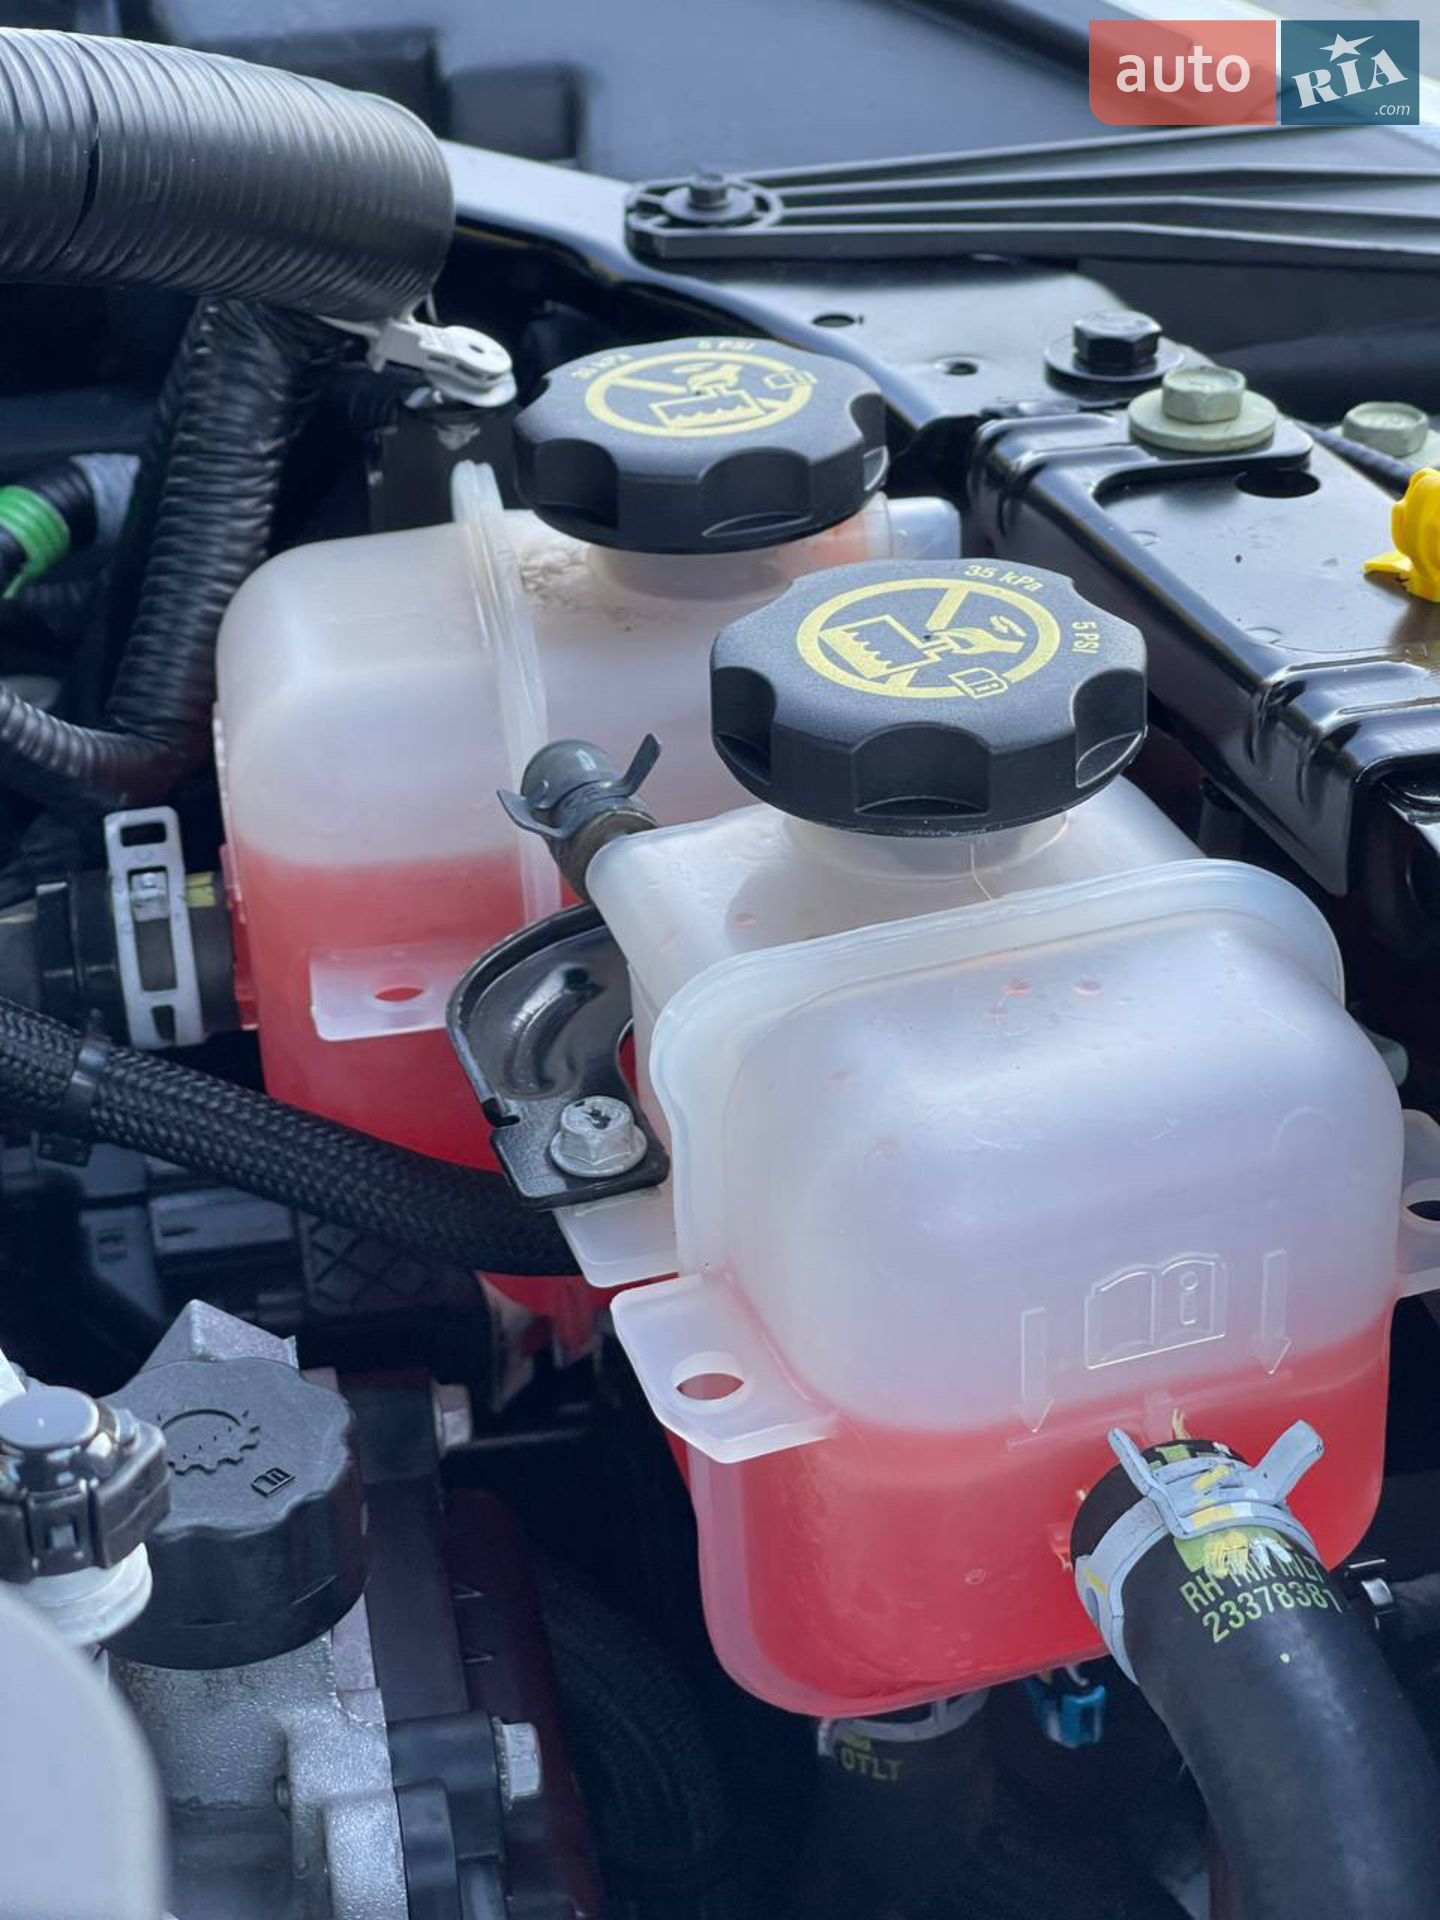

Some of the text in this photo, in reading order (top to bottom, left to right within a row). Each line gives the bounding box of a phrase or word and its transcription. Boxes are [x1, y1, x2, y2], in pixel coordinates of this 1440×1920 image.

[964, 565, 998, 578] 35
[1072, 621, 1100, 654] 5 PSI
[1179, 1568, 1225, 1614] RH
[1202, 1580, 1343, 1643] 23378381
